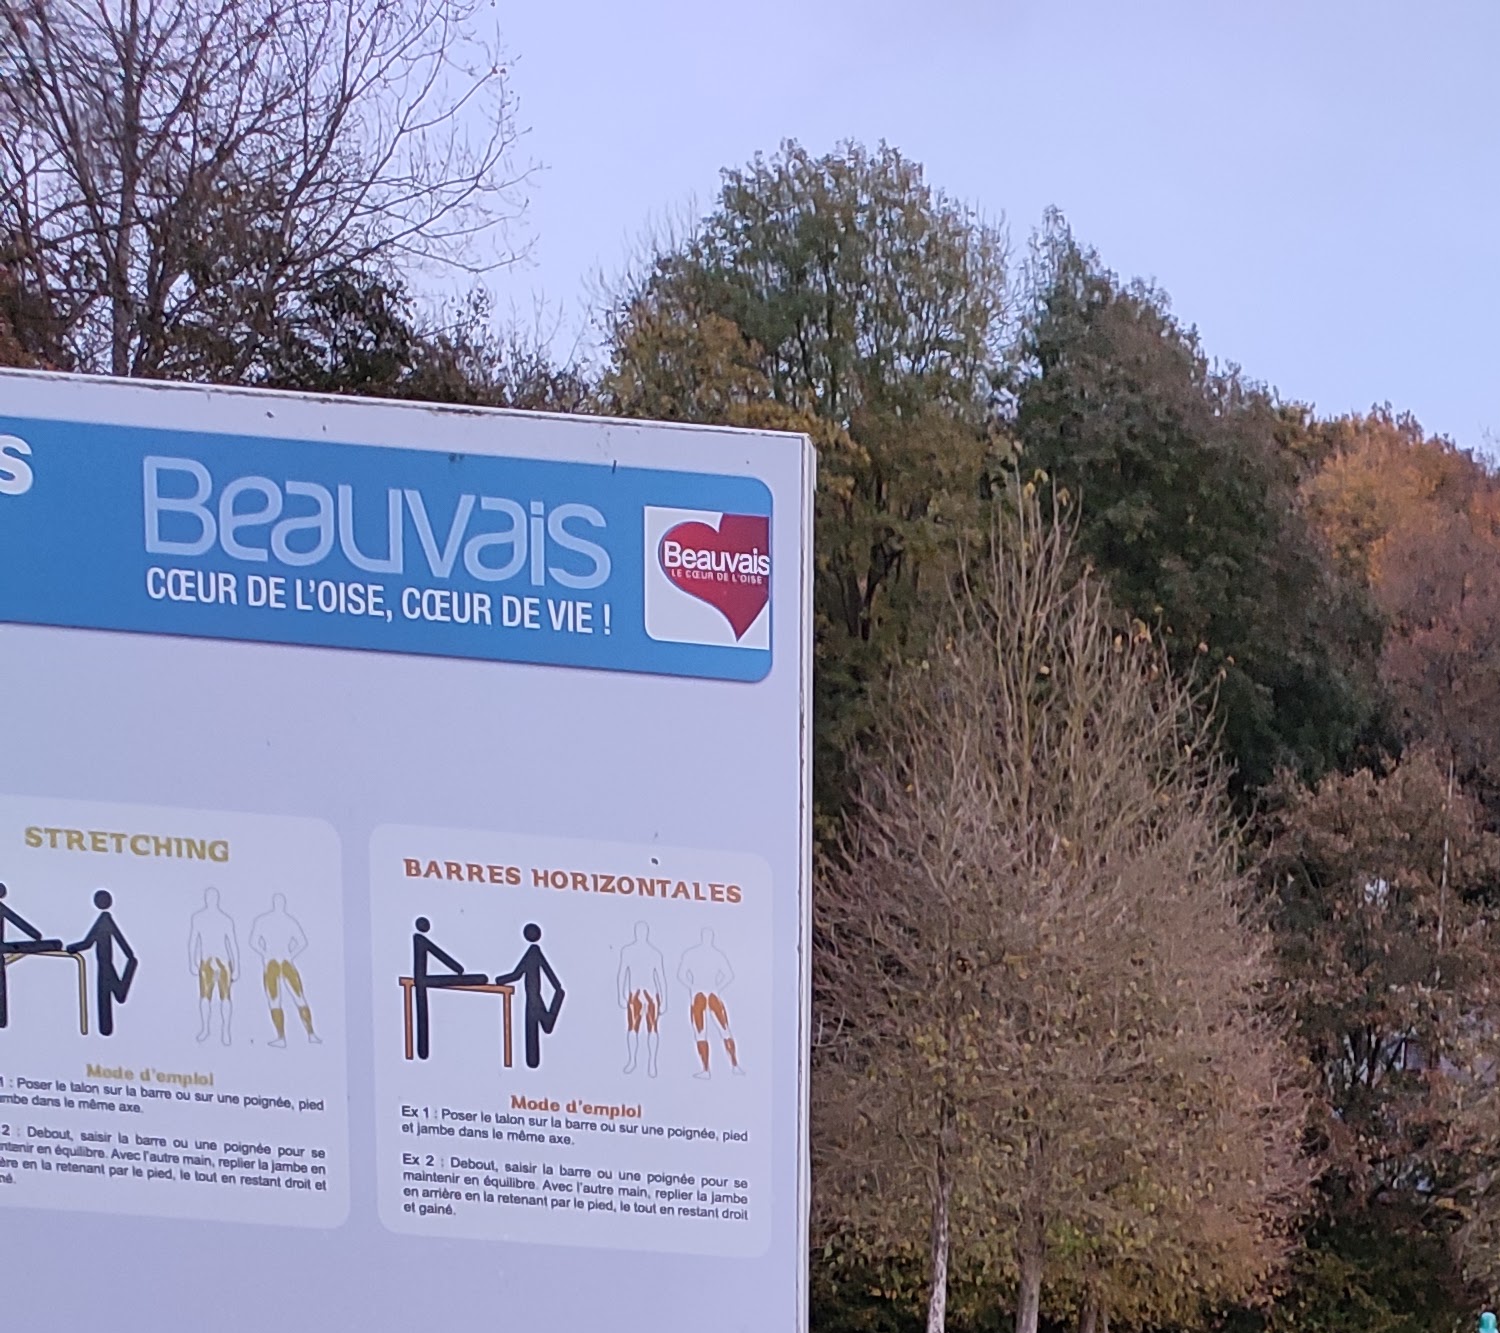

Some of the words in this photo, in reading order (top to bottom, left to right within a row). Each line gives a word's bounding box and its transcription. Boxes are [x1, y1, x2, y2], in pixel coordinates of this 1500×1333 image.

[664, 541, 770, 576] Beauvais
[671, 568, 682, 578] LE
[716, 572, 728, 582] DE
[731, 573, 763, 585] L'OISE
[147, 567, 237, 605] CŒUR
[247, 576, 286, 609] DE
[295, 579, 393, 624] L'OISE,
[402, 586, 492, 625] CŒUR
[502, 595, 541, 630] DE
[549, 598, 594, 635] VIE
[25, 826, 229, 863] STRETCHING
[403, 858, 521, 886] BARRES
[531, 868, 742, 904] HORIZONTALES
[86, 1063, 134, 1080] Mode
[139, 1067, 213, 1086] d'emploi
[510, 1094, 560, 1112] Mode
[565, 1099, 641, 1120] d'emploi
[1, 1123, 10, 1136] 2
[80, 1131, 112, 1143] saisir
[117, 1131, 129, 1144] la
[135, 1133, 167, 1147] barre
[172, 1138, 188, 1148] ou
[194, 1140, 217, 1151] une
[223, 1141, 271, 1155] poignée
[277, 1146, 305, 1158] pour
[311, 1149, 325, 1159] se
[401, 1121, 414, 1133] et
[416, 1121, 455, 1136] jambe
[458, 1125, 488, 1138] dans
[492, 1127, 503, 1140] le
[506, 1129, 545, 1143] même
[548, 1134, 575, 1145] axe.
[402, 1152, 420, 1165] Ex
[425, 1154, 434, 1166] 2
[450, 1156, 498, 1173] Debout,
[504, 1161, 537, 1174] saisir
[542, 1162, 553, 1175] la
[559, 1163, 591, 1178] barre
[596, 1169, 612, 1179] ou
[618, 1170, 641, 1181] une
[646, 1171, 695, 1186] poignée
[700, 1177, 728, 1188] pour
[733, 1179, 748, 1189] se
